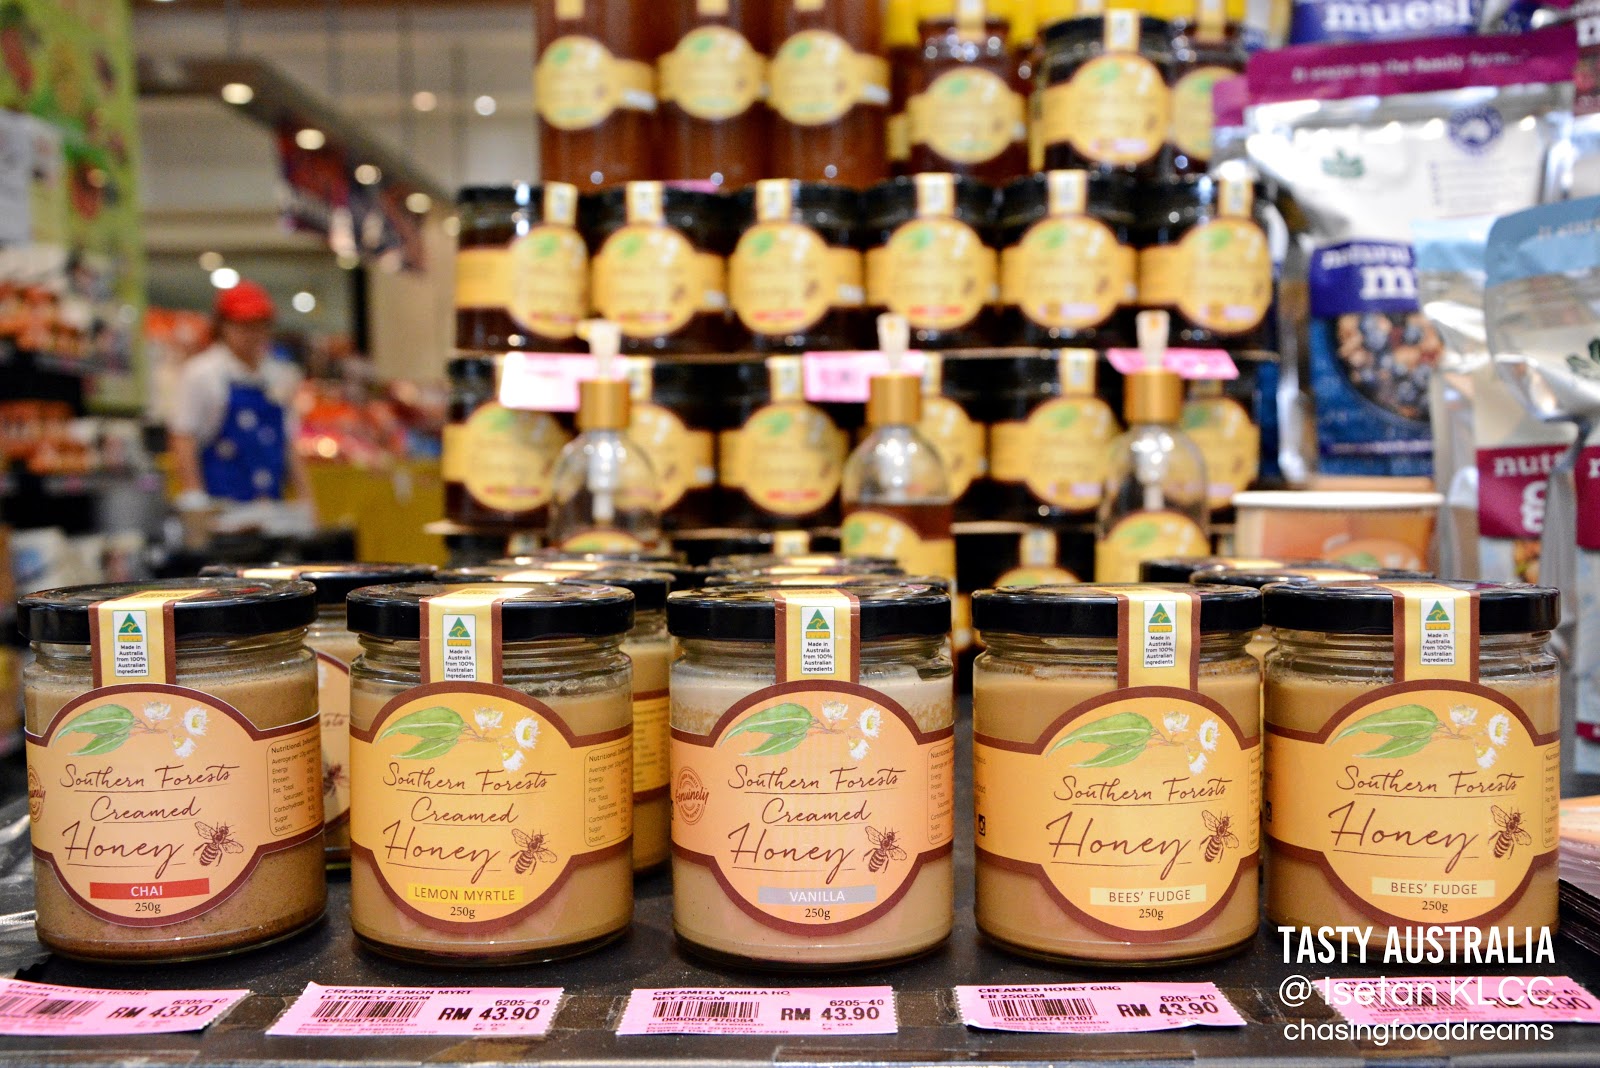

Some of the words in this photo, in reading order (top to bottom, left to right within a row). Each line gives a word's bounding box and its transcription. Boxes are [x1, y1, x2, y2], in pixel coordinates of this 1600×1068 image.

[60, 764, 144, 789] Southern
[155, 764, 240, 787] Forests
[383, 762, 465, 790] Southern
[475, 769, 557, 792] Forests
[727, 764, 819, 789] Southern
[829, 767, 907, 791] Forests
[1336, 765, 1437, 793] Southern
[1449, 771, 1525, 795] Forests
[1054, 776, 1152, 802] Southern
[1163, 777, 1233, 801] Forests
[90, 796, 201, 821] Creamed
[410, 797, 519, 823] Creamed
[761, 797, 872, 824] Creamed
[1328, 801, 1479, 874] Honey
[62, 821, 184, 879] Honey
[383, 820, 500, 884] Honey
[727, 822, 855, 885] Honey
[1046, 811, 1191, 881] Honey
[131, 886, 163, 897] CHAI
[415, 887, 458, 900] LEMON
[464, 889, 515, 901] MYRTLE
[789, 891, 846, 902] VANILLA
[1150, 890, 1191, 902] FUDGE
[1434, 883, 1478, 895] FUDGE
[135, 902, 161, 914] 250g
[450, 906, 475, 919] 250g
[805, 908, 831, 920] 250g
[1139, 908, 1164, 920] 250g
[1422, 900, 1449, 914] 250g
[829, 999, 884, 1007] 6205-40
[1160, 994, 1216, 1002] 6205-40
[106, 1006, 148, 1019] RM
[149, 1005, 213, 1018] 43.90
[437, 1007, 474, 1021] RM
[478, 1007, 540, 1021] 43.90
[781, 1007, 811, 1021] RM
[820, 1006, 880, 1021] 43.90
[1116, 1004, 1151, 1017] RM
[1159, 1001, 1219, 1016] 43.90
